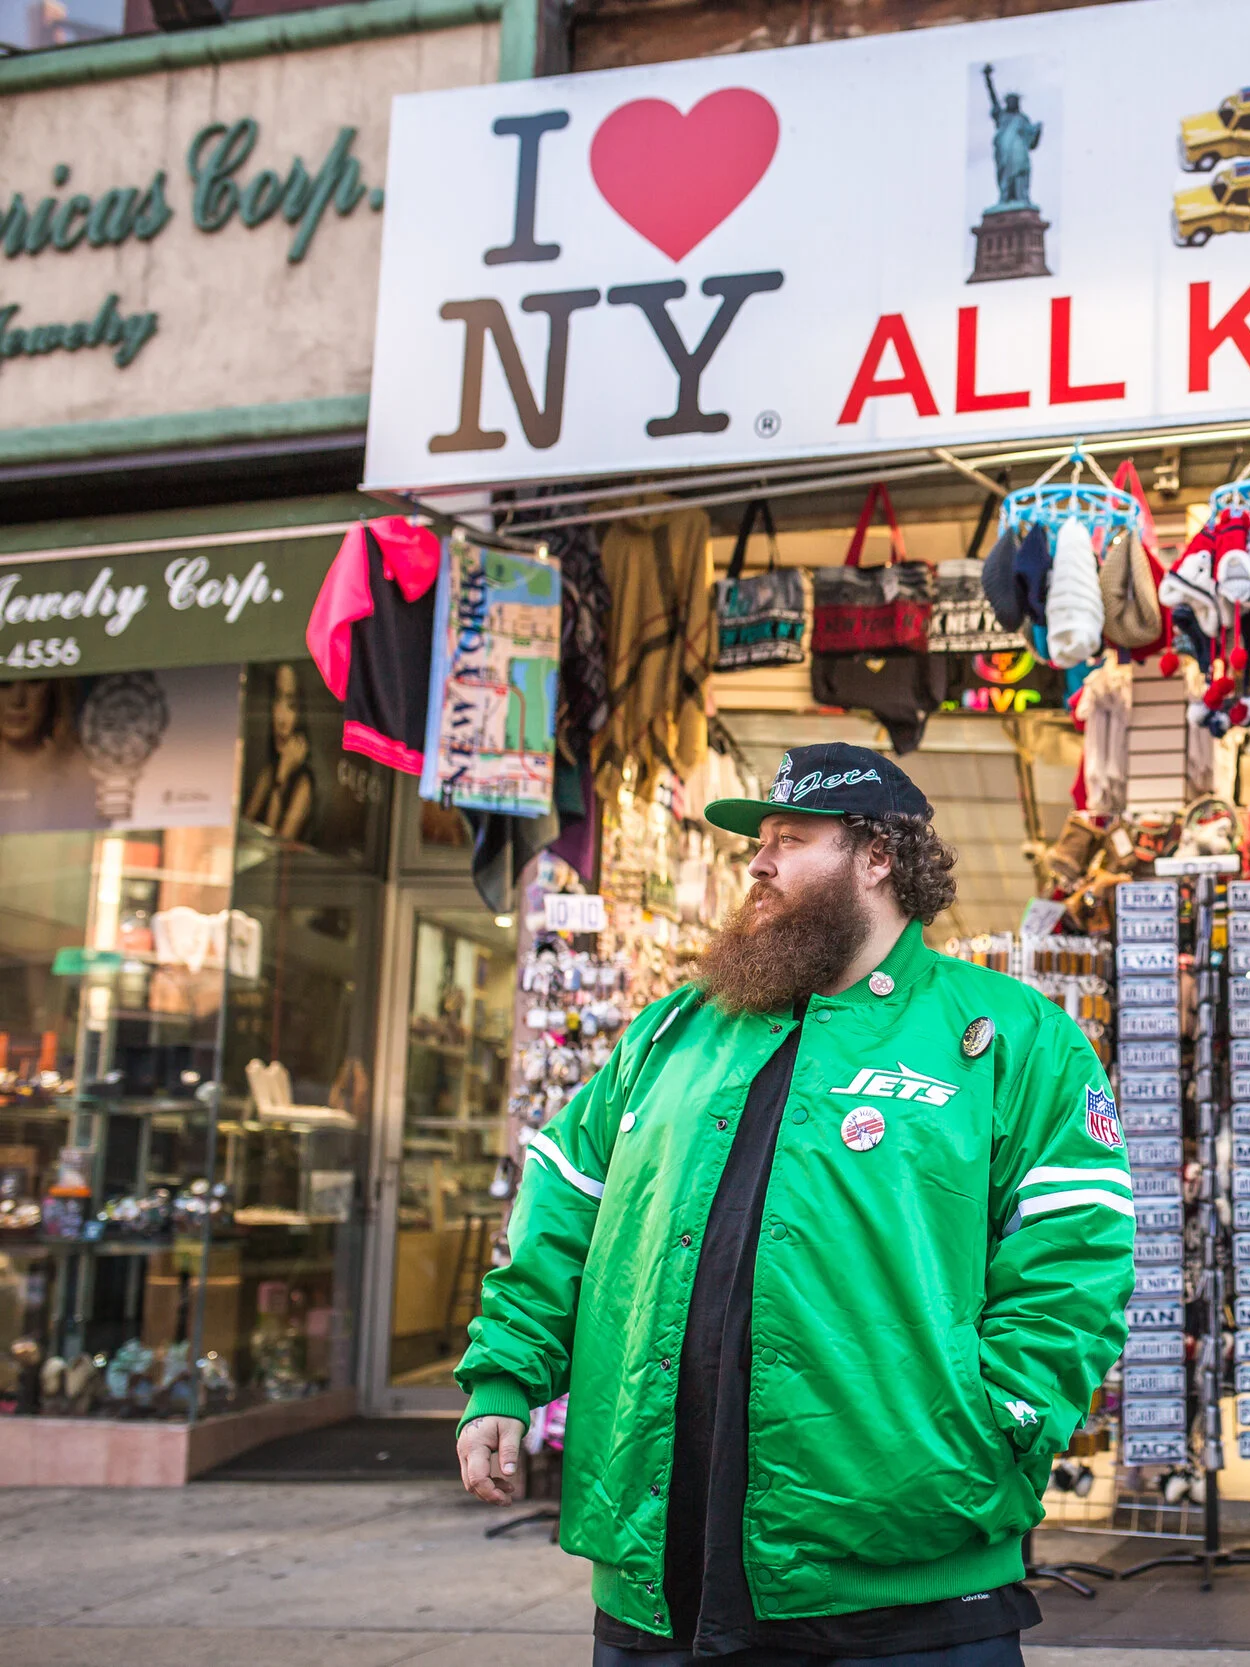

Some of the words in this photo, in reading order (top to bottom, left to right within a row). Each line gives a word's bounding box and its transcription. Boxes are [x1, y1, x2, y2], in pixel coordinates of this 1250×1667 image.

[187, 118, 384, 264] Corp.
[483, 110, 571, 266] I
[428, 270, 784, 455] NY
[837, 296, 1126, 426] ALL
[164, 555, 284, 624] Corp.
[455, 570, 488, 681] YORK
[792, 769, 882, 802] Jets
[1122, 953, 1173, 965] EVAN
[829, 1060, 960, 1108] JETS
[1125, 1084, 1176, 1096] GREG
[1089, 1111, 1121, 1146] NFL
[1132, 1310, 1175, 1324] IAN
[1131, 1443, 1180, 1457] JACK
